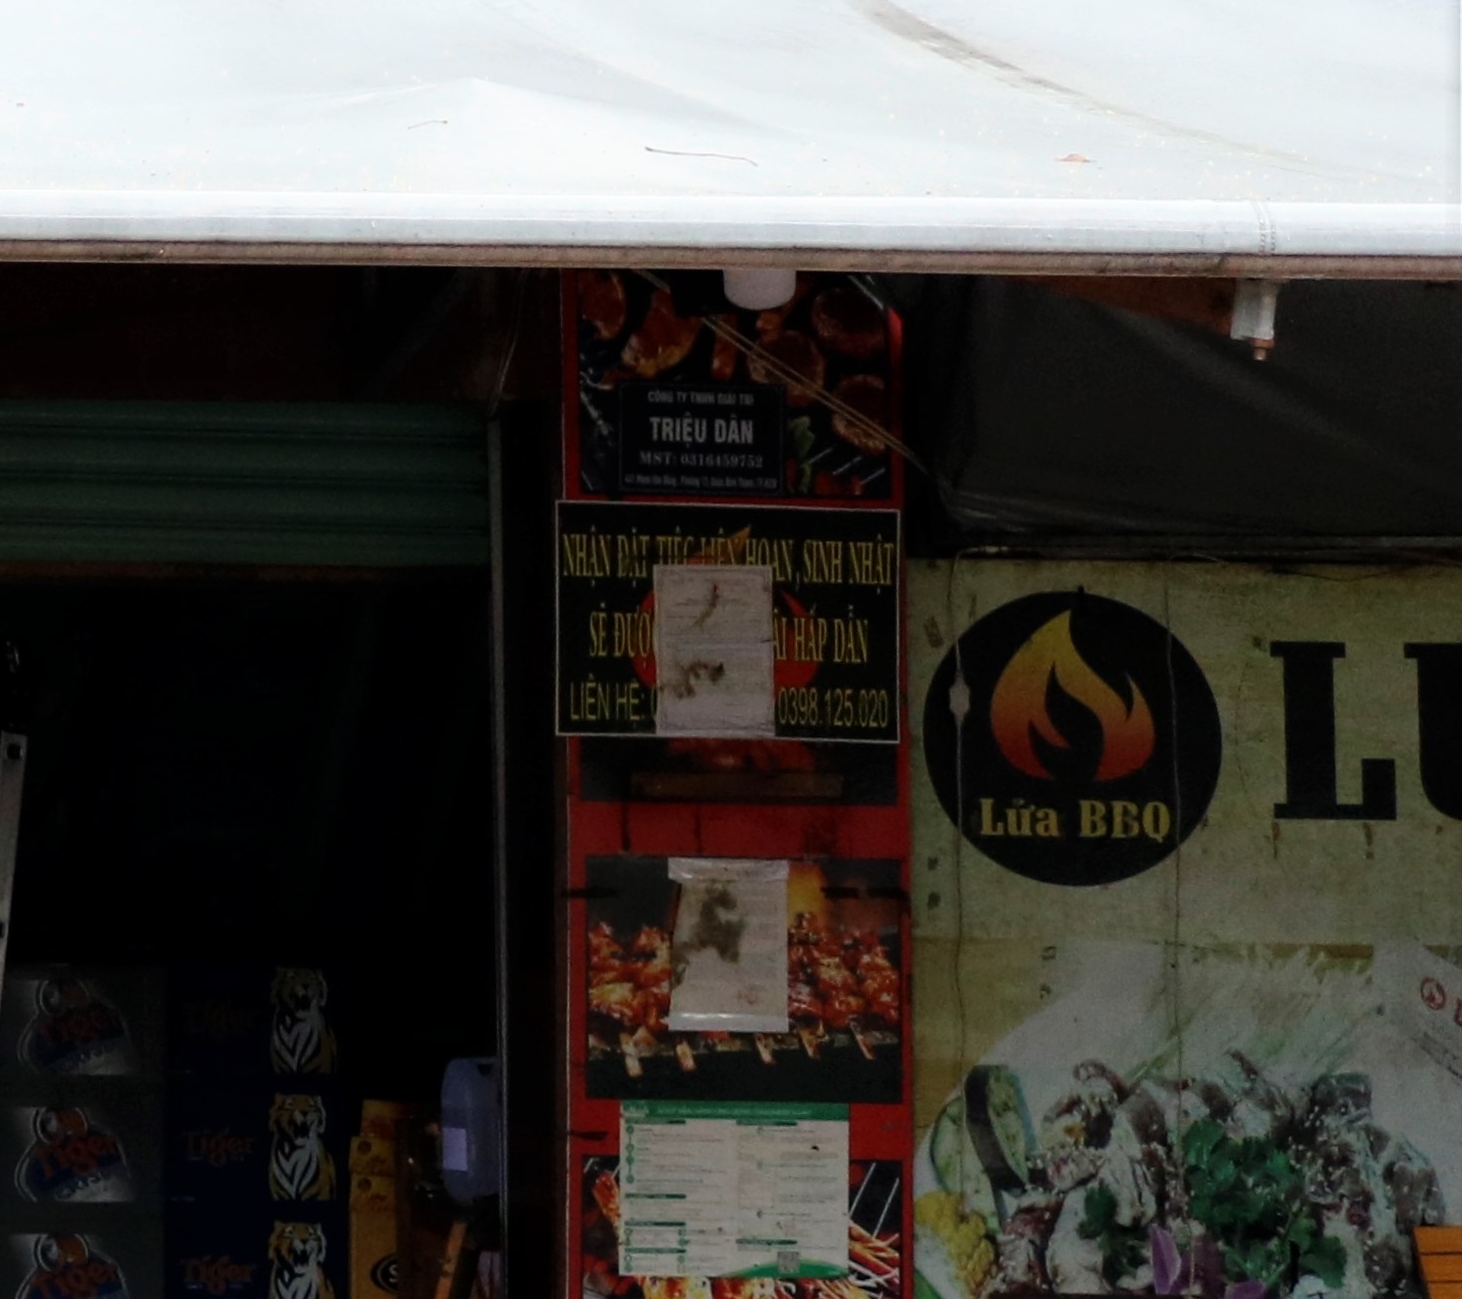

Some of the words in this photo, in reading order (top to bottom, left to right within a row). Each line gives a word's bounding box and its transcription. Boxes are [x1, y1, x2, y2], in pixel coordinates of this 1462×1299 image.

[649, 411, 707, 449] TRIỆU
[714, 412, 754, 445] DÂN
[568, 673, 610, 722] LIÊN
[1078, 800, 1171, 843] BBQ
[179, 1253, 257, 1295] Tiger
